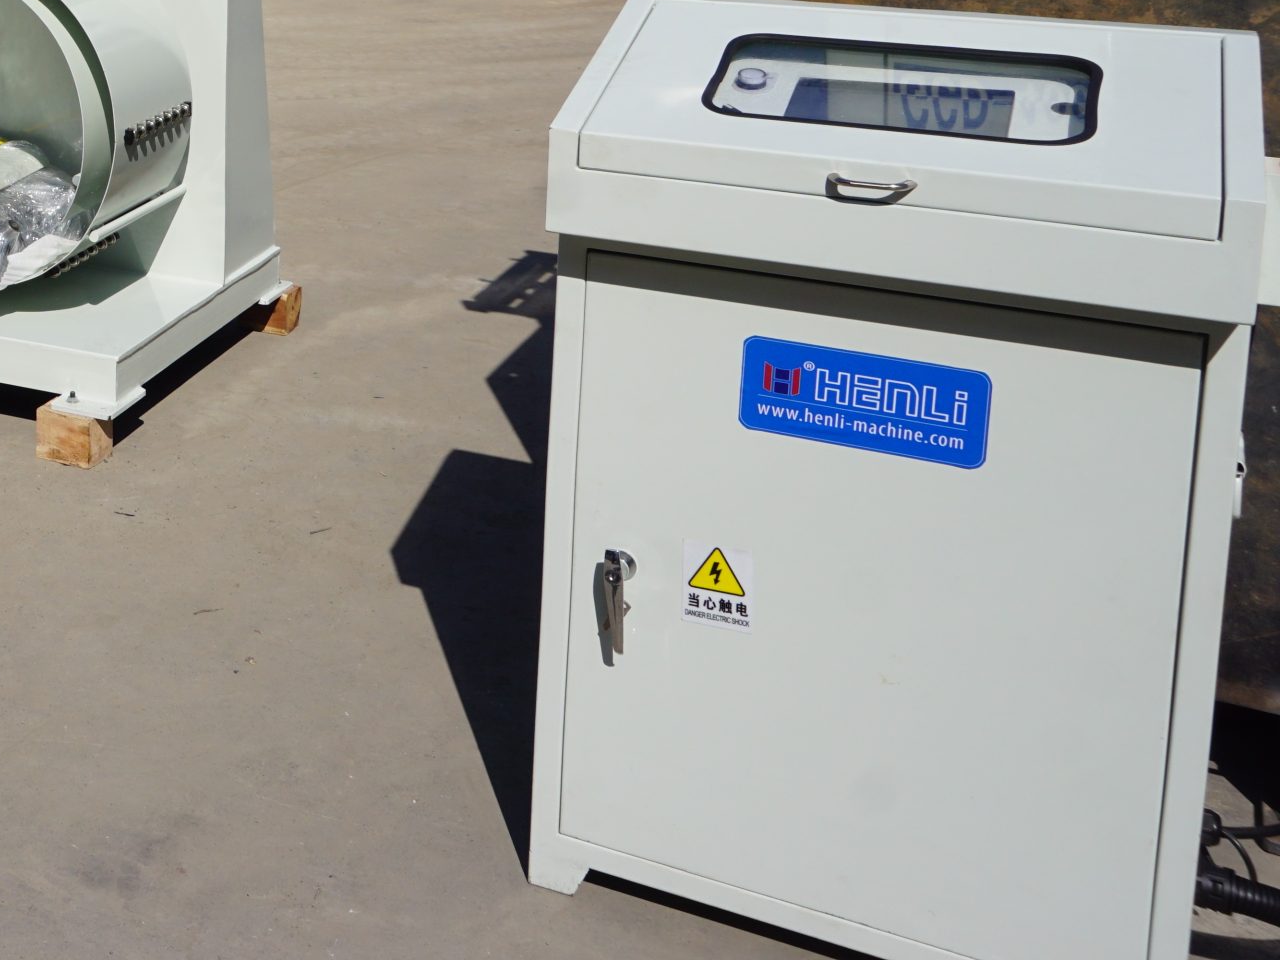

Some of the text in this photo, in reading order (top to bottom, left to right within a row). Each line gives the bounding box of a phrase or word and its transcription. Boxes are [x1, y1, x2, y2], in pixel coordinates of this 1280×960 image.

[756, 402, 965, 451] www.henli-machine.com
[688, 592, 749, 617] 当心触电
[684, 608, 750, 628] DANGER ELECTRIC SHOCK
